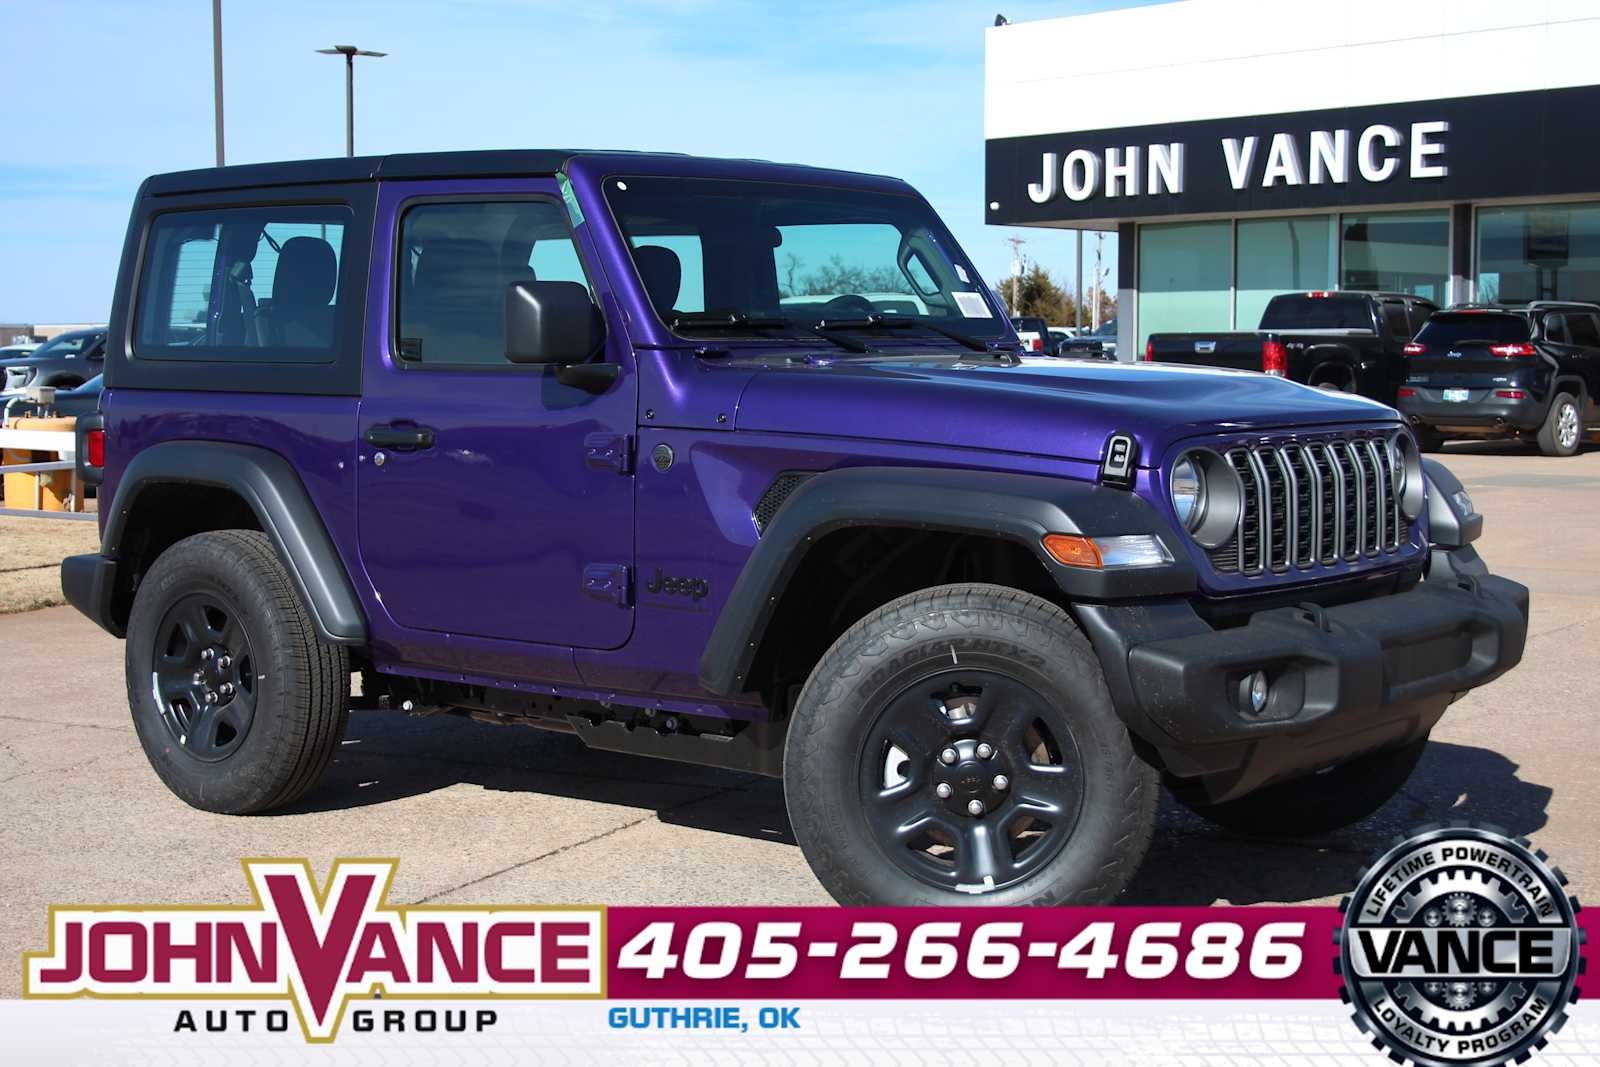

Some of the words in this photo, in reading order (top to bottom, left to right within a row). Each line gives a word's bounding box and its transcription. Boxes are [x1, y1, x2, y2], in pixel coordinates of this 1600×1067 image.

[1027, 142, 1184, 204] JOHN
[1221, 120, 1450, 190] VANCE
[647, 567, 709, 602] Jeep
